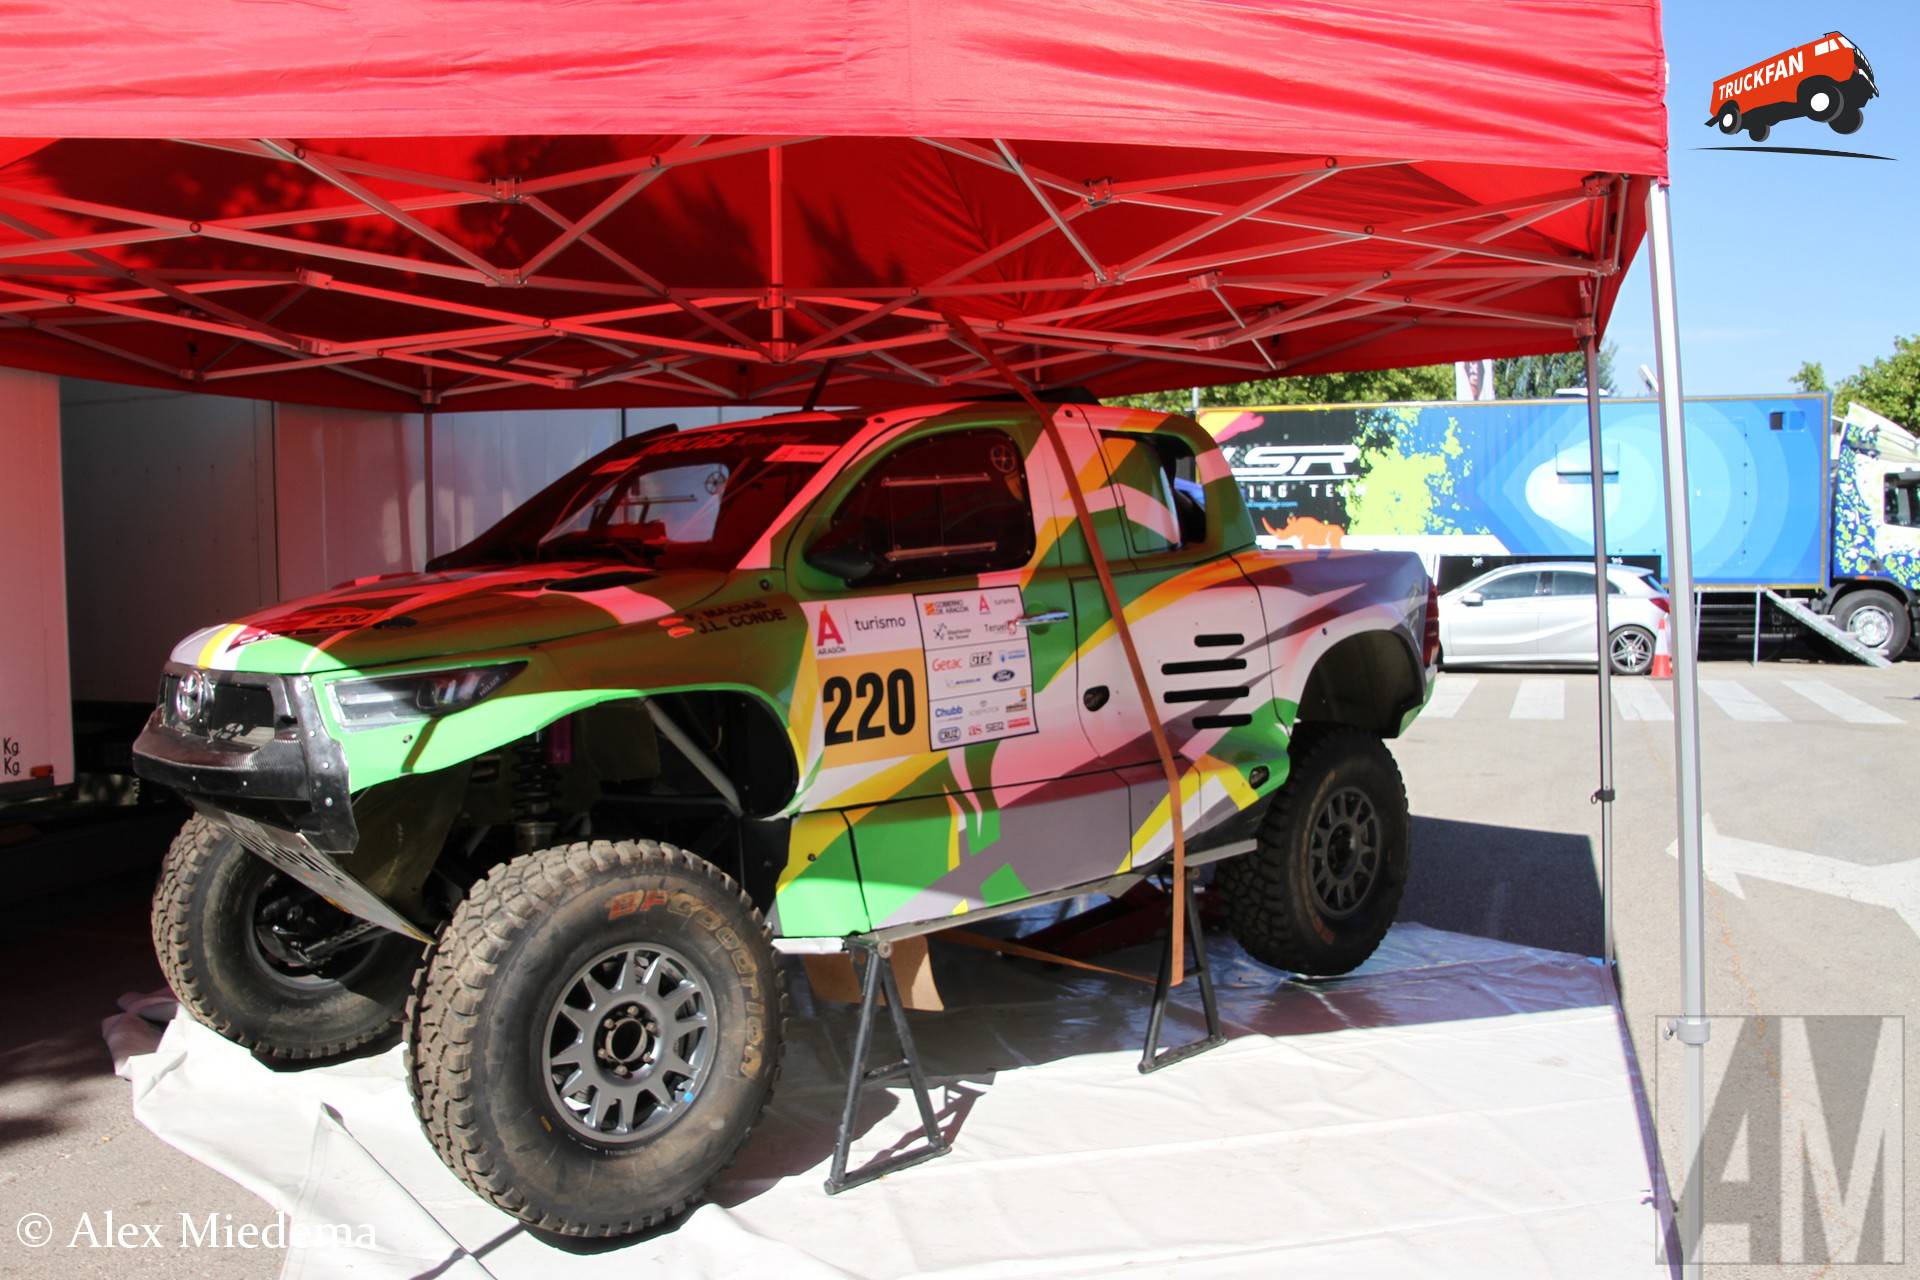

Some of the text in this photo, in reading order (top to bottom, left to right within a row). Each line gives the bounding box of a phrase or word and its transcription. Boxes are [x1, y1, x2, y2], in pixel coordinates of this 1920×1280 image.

[1249, 484, 1288, 498] ING
[318, 613, 374, 625] 220
[729, 608, 787, 627] CONDE
[854, 615, 906, 631] turismo
[984, 623, 1008, 633] Teruel
[932, 658, 963, 672] Getac
[822, 668, 916, 747] 220
[935, 706, 963, 718] Chubb
[968, 725, 982, 736] as
[3, 736, 20, 757] Kg
[4, 757, 21, 776] Kg
